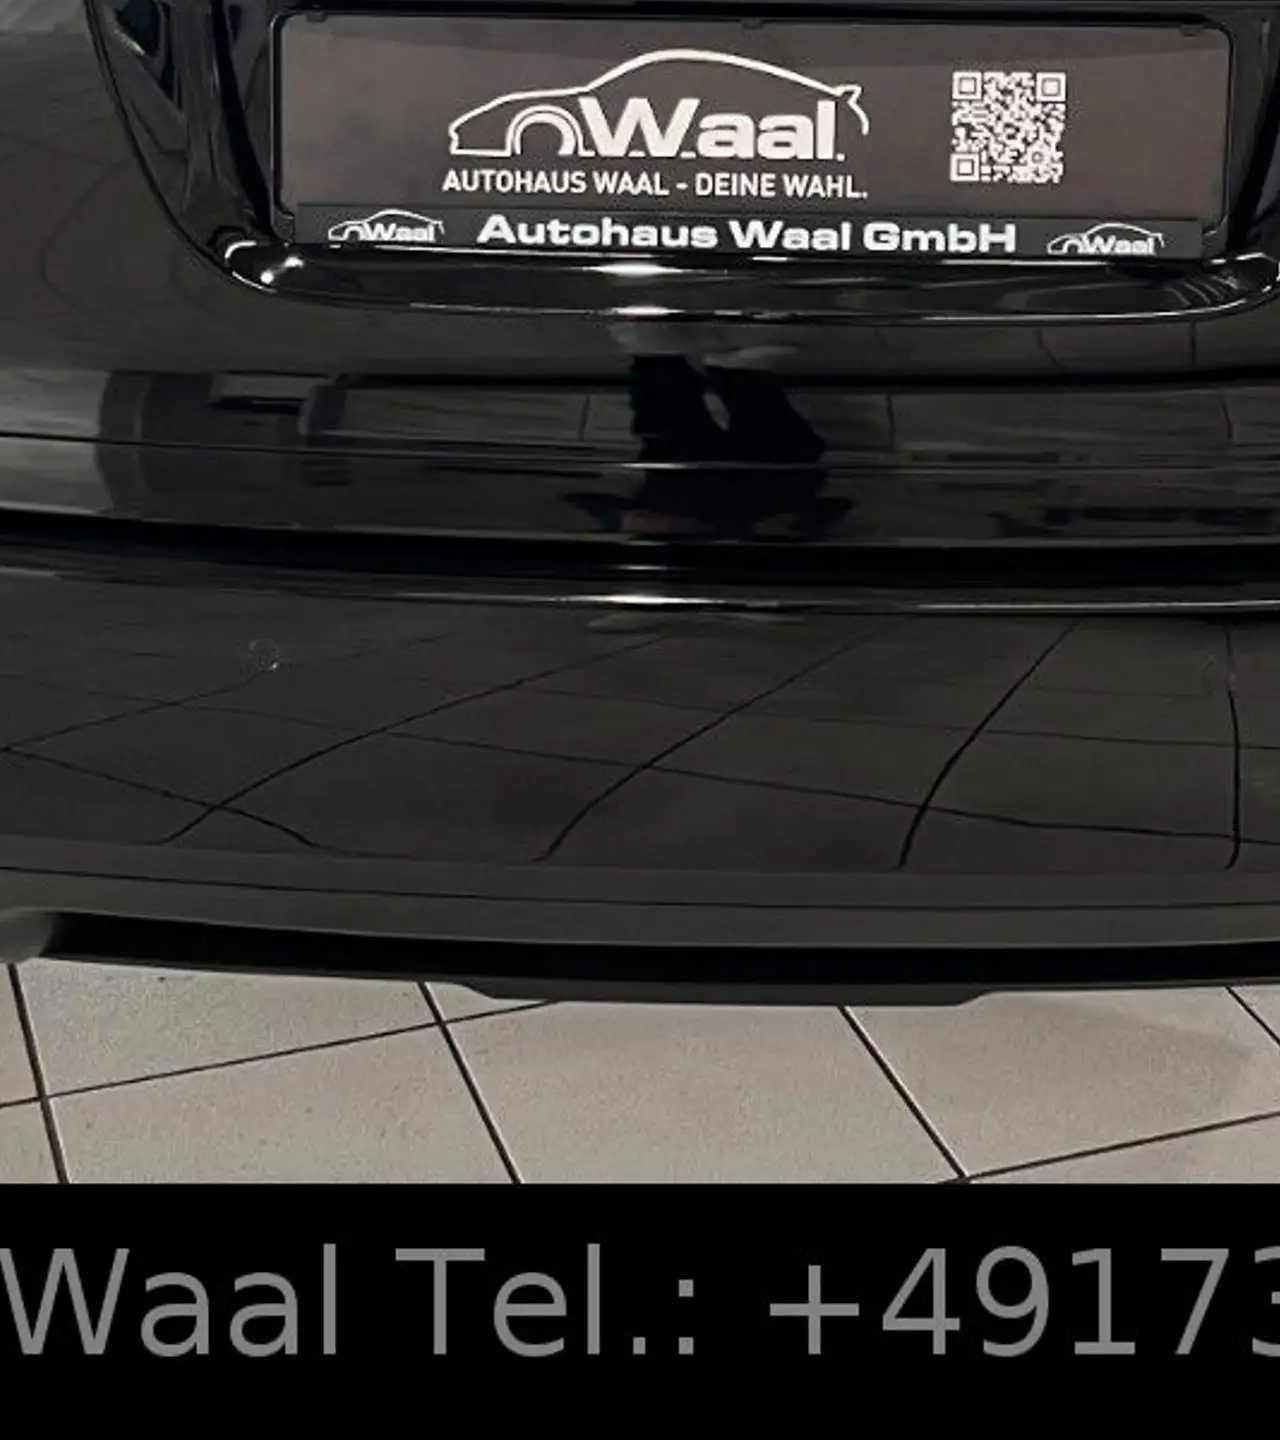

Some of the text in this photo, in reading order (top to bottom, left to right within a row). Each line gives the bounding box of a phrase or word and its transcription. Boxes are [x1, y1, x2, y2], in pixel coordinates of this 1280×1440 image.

[442, 169, 587, 194] AUTOHAUS
[594, 171, 669, 196] WAAL
[695, 173, 776, 198] DEINE
[783, 174, 869, 199] WAHL.
[362, 222, 435, 242] Waal
[476, 215, 1016, 253] Autohaus Waal GmbH
[1082, 234, 1155, 255] Waal
